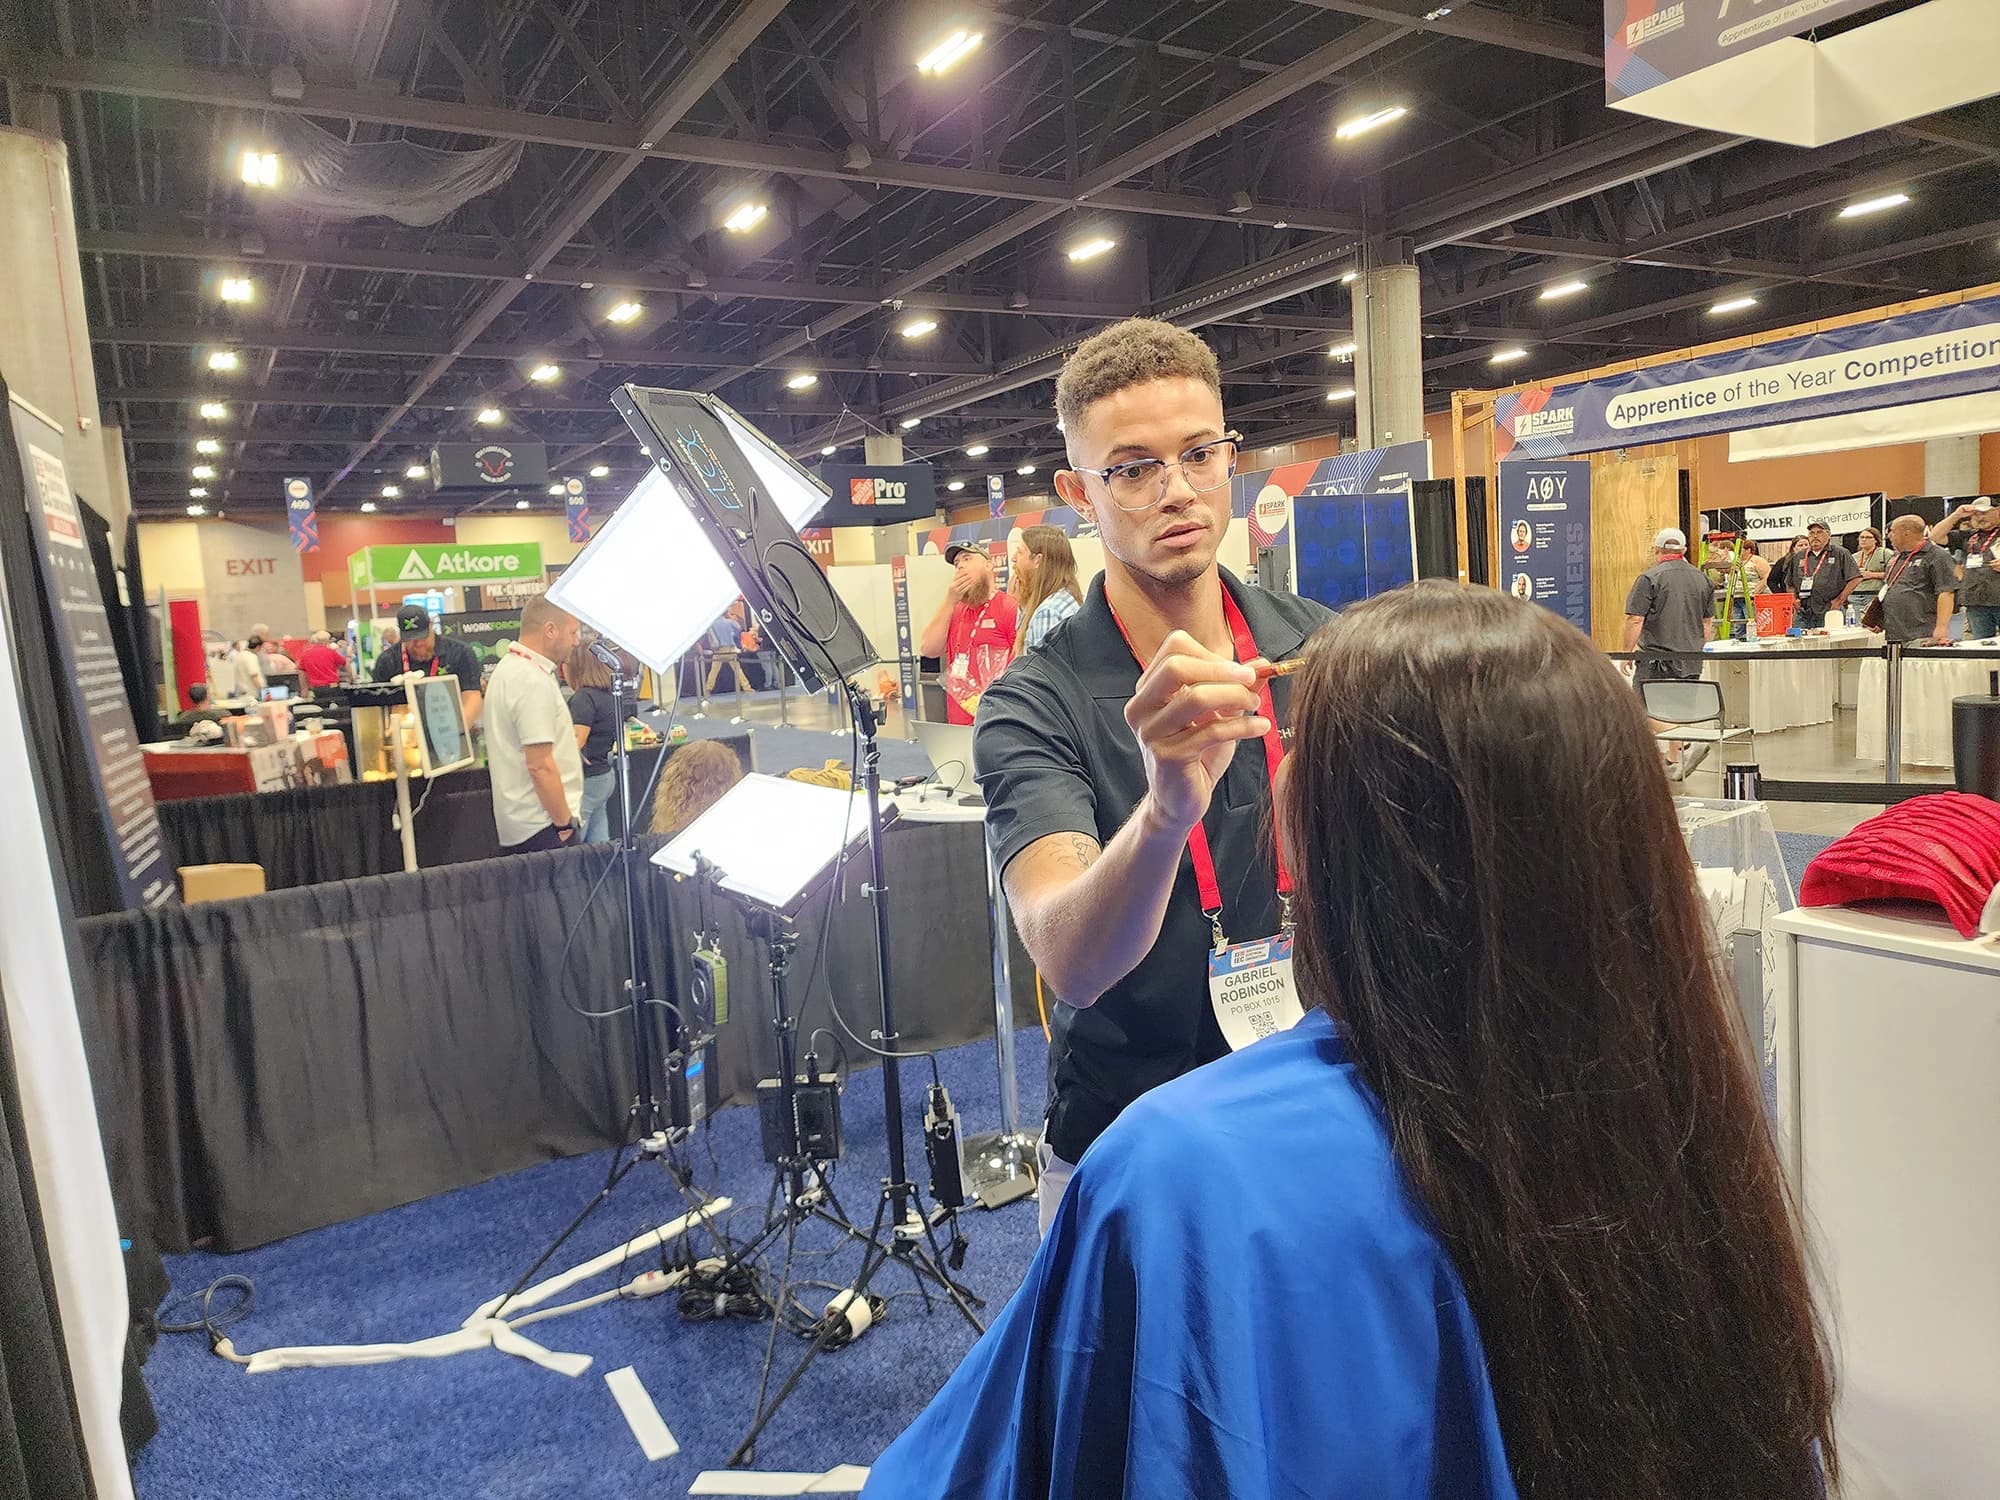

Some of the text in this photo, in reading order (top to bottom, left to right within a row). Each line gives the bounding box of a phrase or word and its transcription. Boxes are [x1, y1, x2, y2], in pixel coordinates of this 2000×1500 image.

[1644, 2, 1685, 29] SPARK
[1721, 18, 1772, 42] Apprentice
[1784, 8, 1798, 19] the
[1613, 338, 2000, 423] Apprentice of the Year Competition
[1532, 406, 1575, 426] SPARK
[874, 478, 908, 498] Pro
[1744, 516, 1793, 530] KOHLER
[803, 539, 832, 555] XIT
[226, 558, 279, 576] EXIT
[436, 550, 520, 573] Atkore
[1565, 522, 1584, 626] NNERS
[1224, 965, 1277, 988] GABRIEL
[1220, 977, 1285, 1005] ROBINSON
[1230, 995, 1281, 1015] PO BOX 1015
